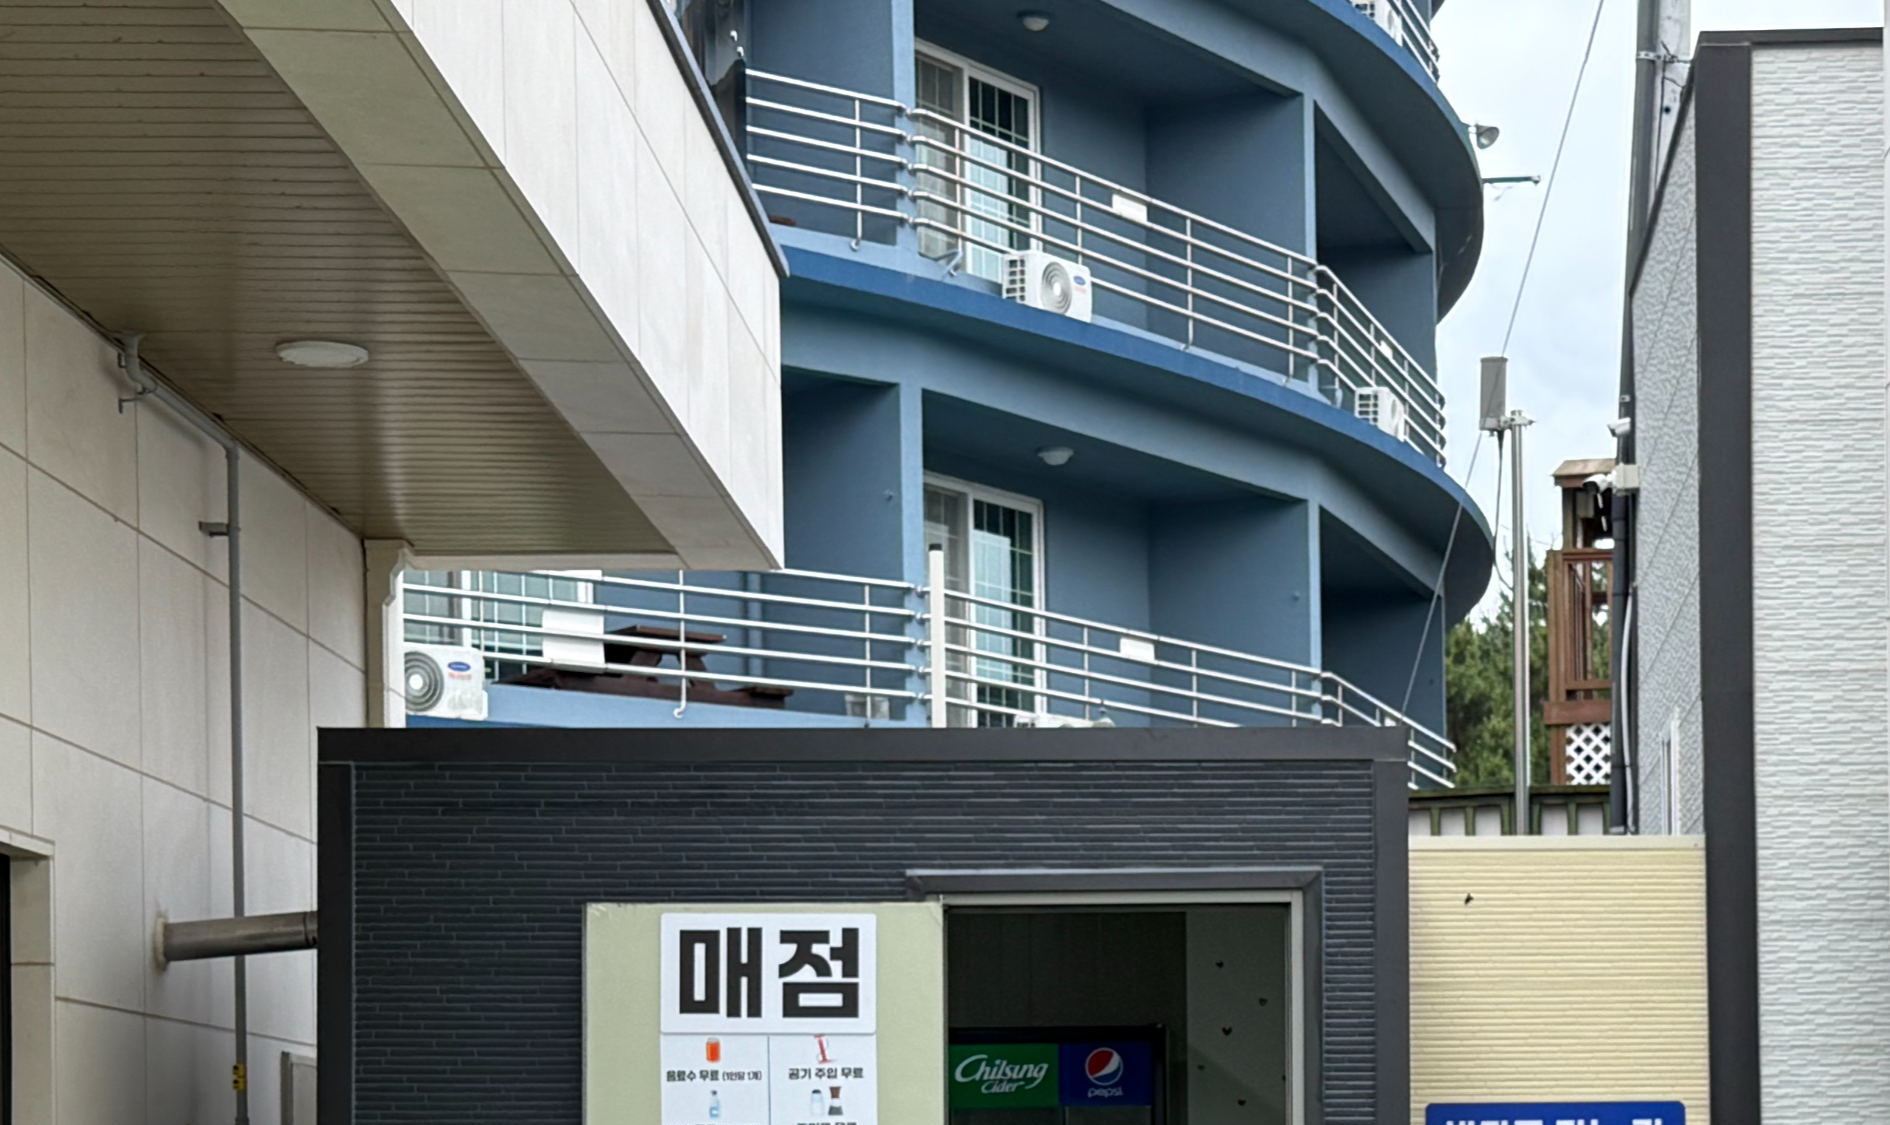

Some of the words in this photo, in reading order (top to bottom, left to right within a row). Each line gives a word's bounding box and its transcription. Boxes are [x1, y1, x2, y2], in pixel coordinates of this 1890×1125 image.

[679, 927, 859, 1018] 매점
[666, 1070, 697, 1082] 음료수
[699, 1070, 720, 1082] 무료
[788, 1067, 812, 1080] 공기
[815, 1067, 838, 1080] 주입
[841, 1067, 864, 1079] 무료
[954, 1054, 1049, 1090] Chilsung
[981, 1080, 1025, 1095] Cider
[1087, 1087, 1123, 1098] pepsi
